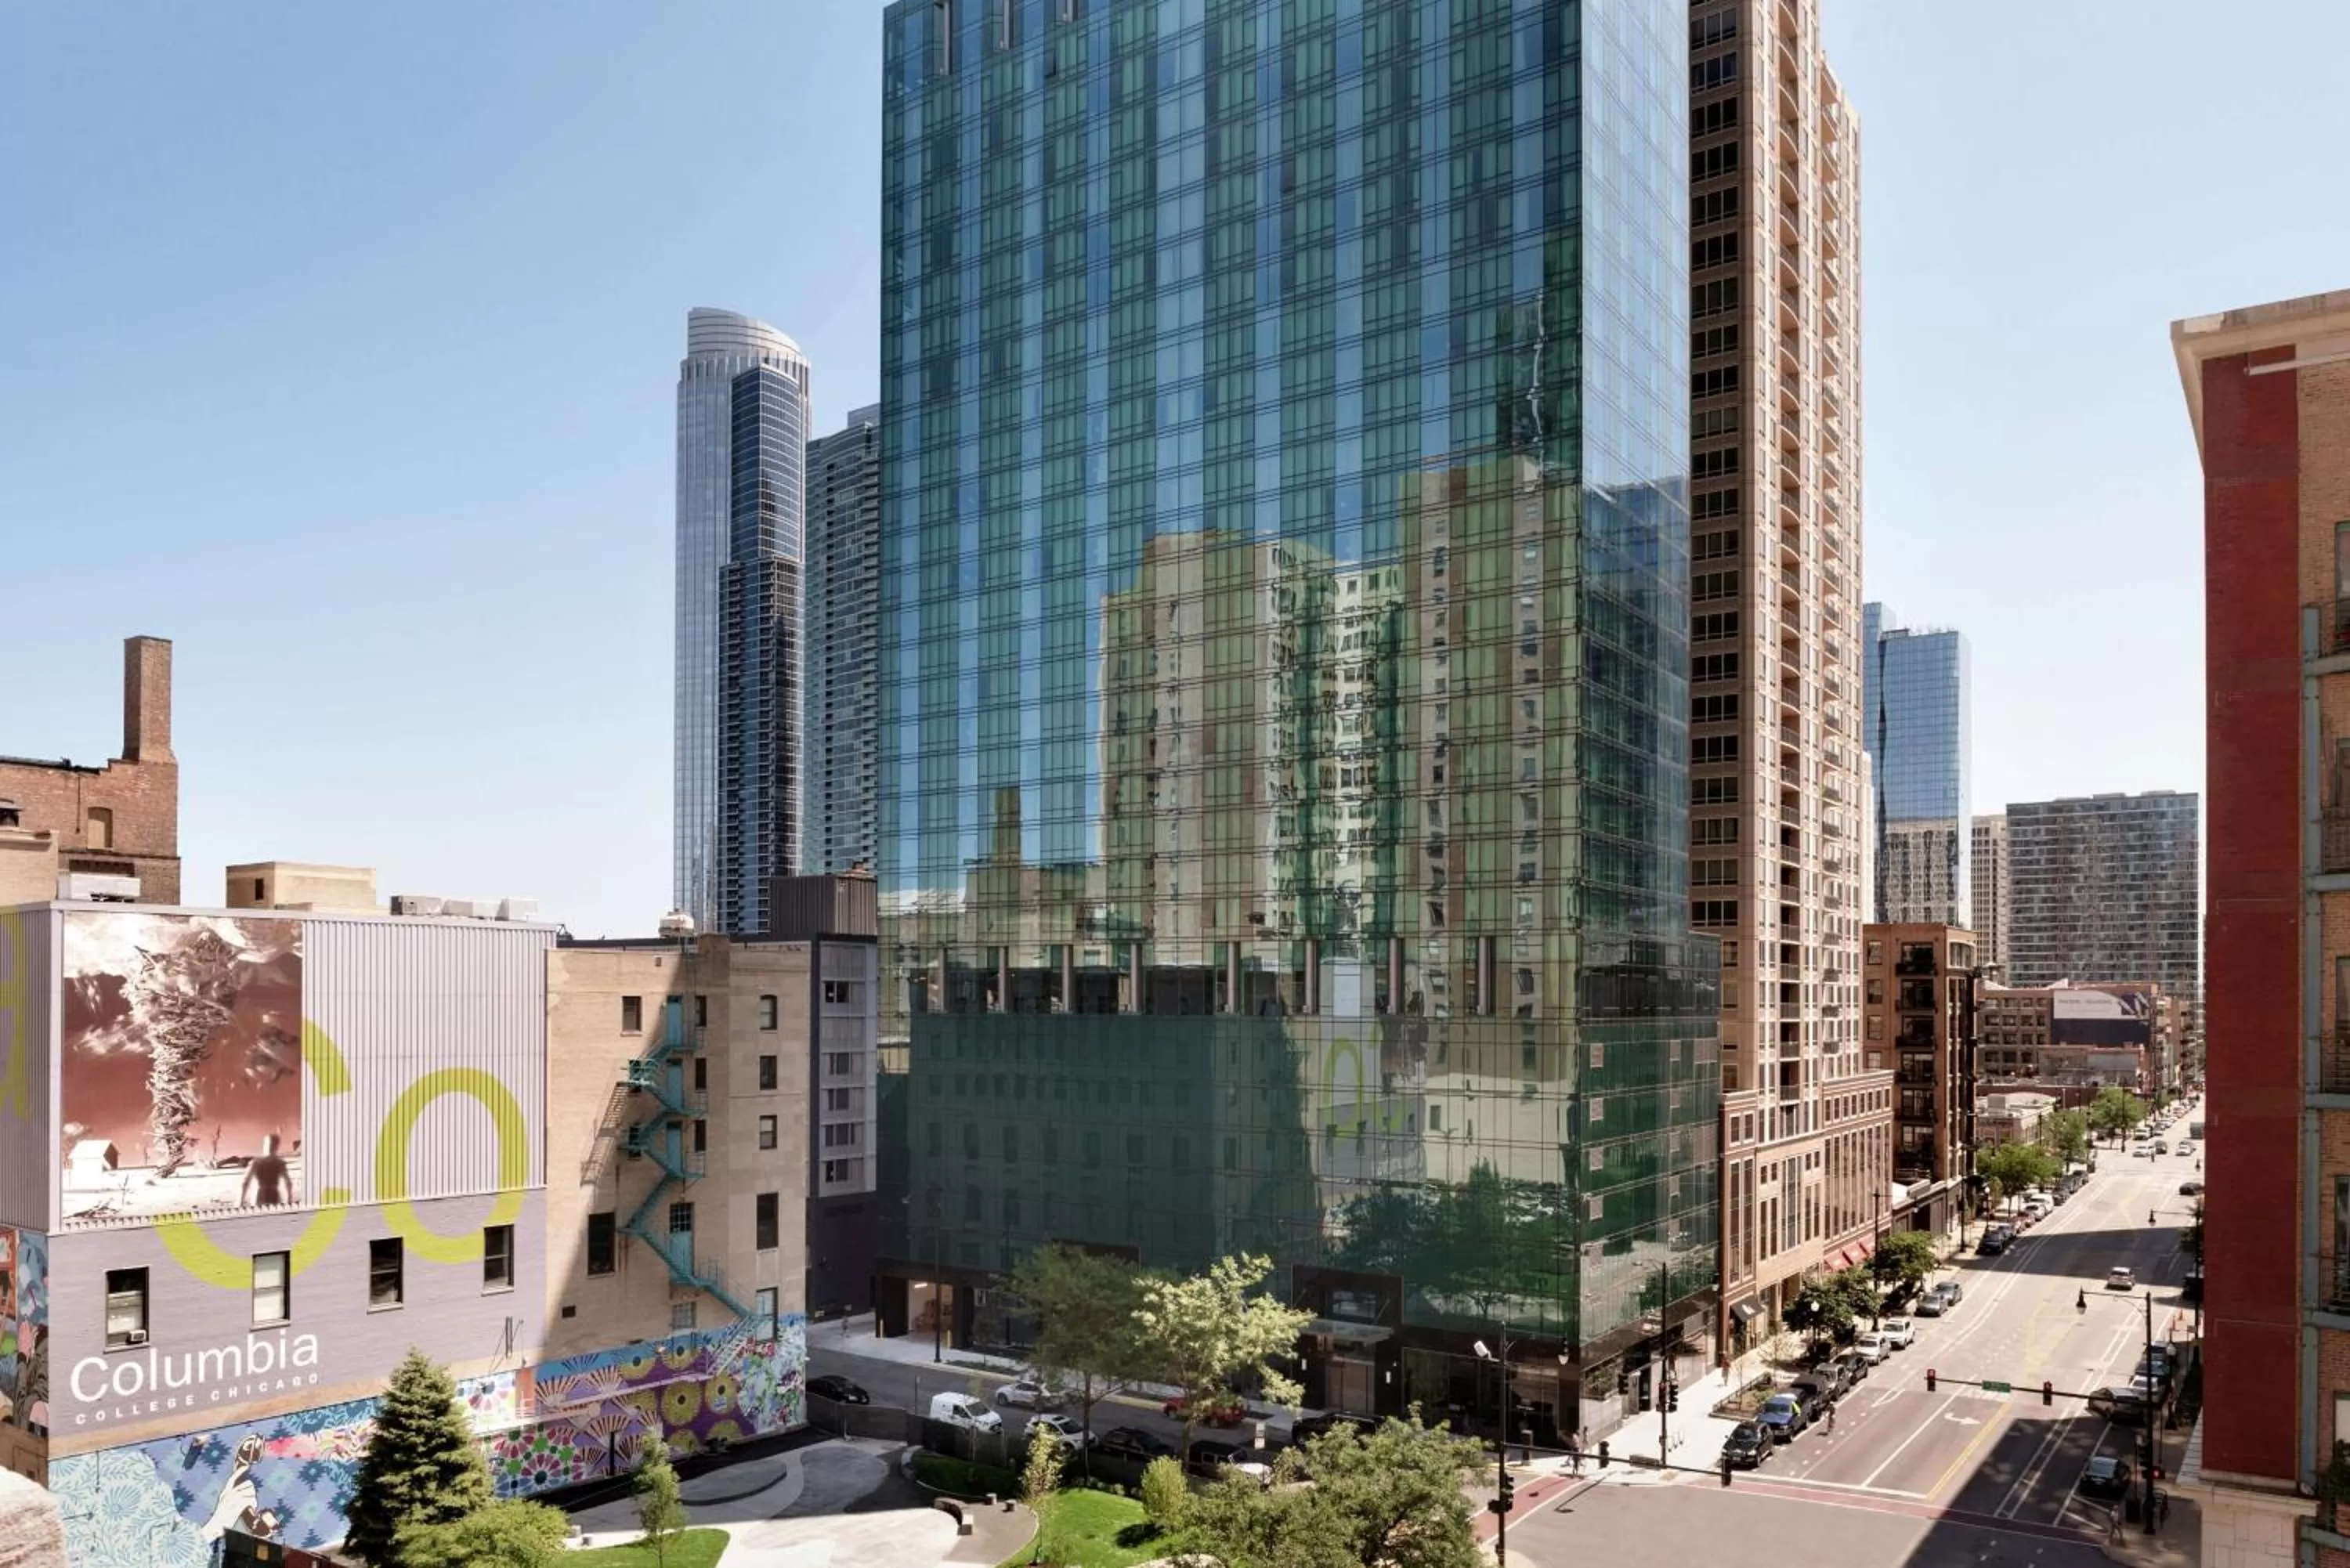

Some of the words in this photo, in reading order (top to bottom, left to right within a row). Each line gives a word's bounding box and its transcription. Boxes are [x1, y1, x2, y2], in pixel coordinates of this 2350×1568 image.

[70, 1329, 319, 1402] Columbia
[75, 1394, 196, 1425] COLLEGE
[210, 1373, 319, 1401] CHICAGO
